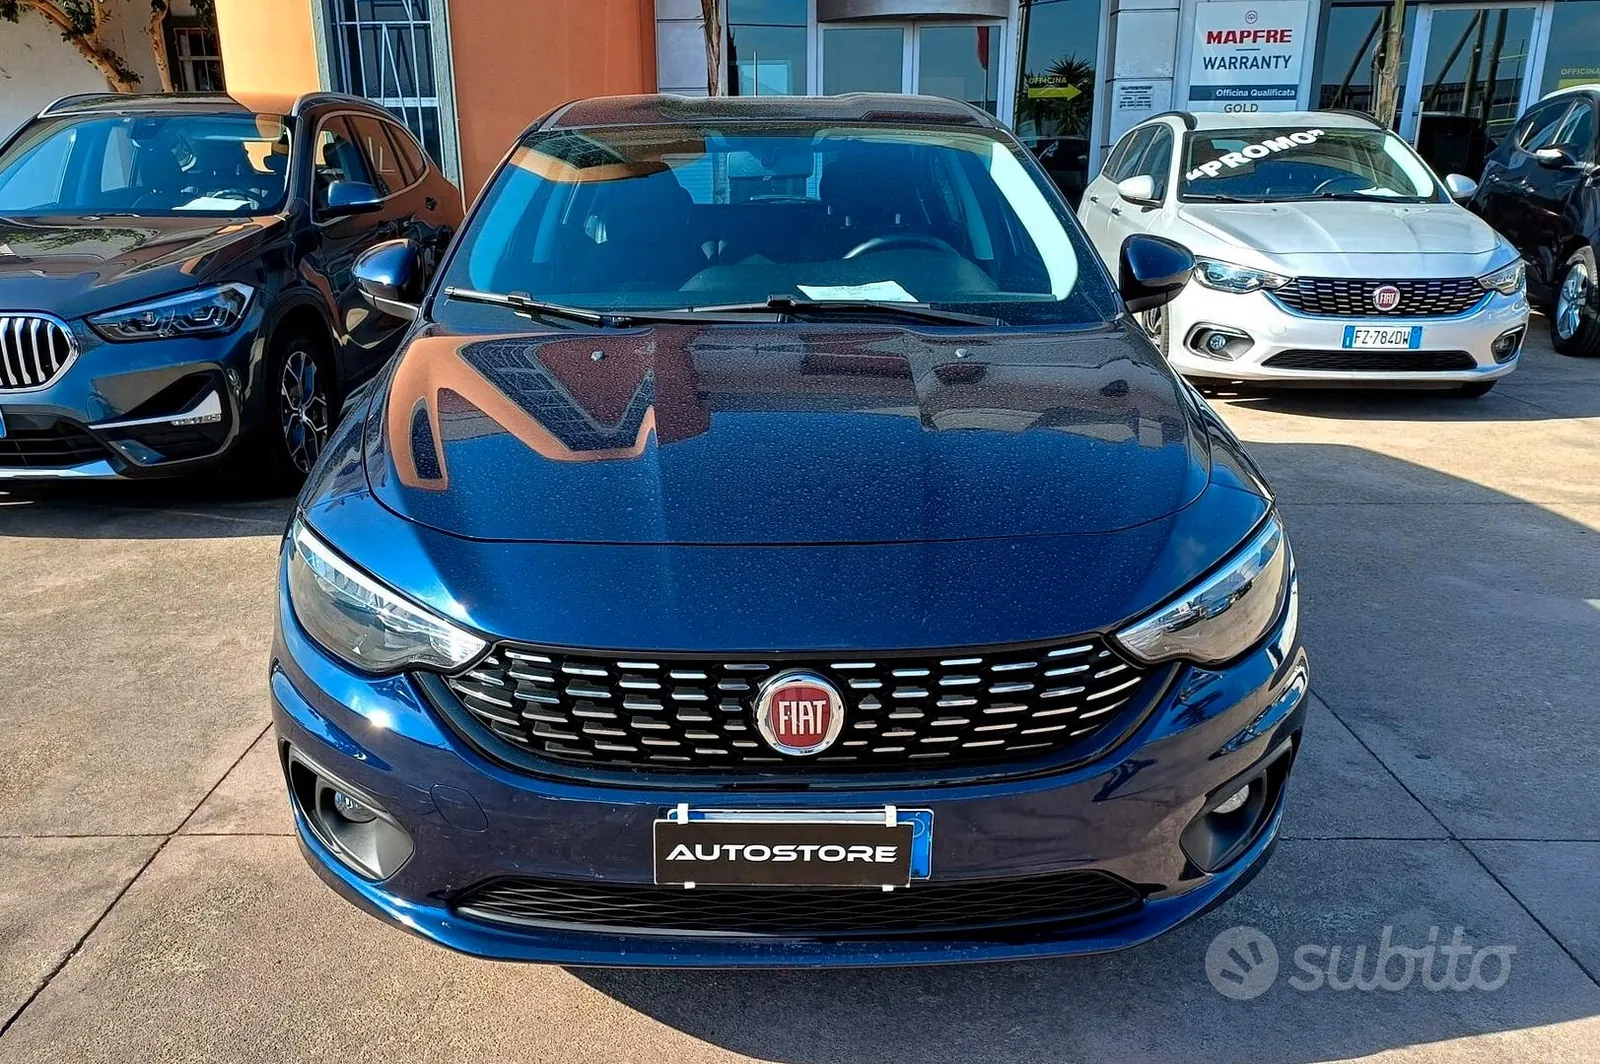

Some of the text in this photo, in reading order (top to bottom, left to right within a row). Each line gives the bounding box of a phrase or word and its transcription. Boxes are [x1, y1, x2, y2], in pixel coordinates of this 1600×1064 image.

[1206, 29, 1293, 44] MAPFRE
[1203, 55, 1292, 70] WARRANTY
[1028, 76, 1067, 84] OFFICINA
[1216, 87, 1295, 97] Officina Qualificata
[1224, 103, 1259, 113] GOLD
[1380, 292, 1396, 304] FIAT
[778, 700, 827, 735] FIAT
[665, 843, 898, 863] AUTOSTORE
